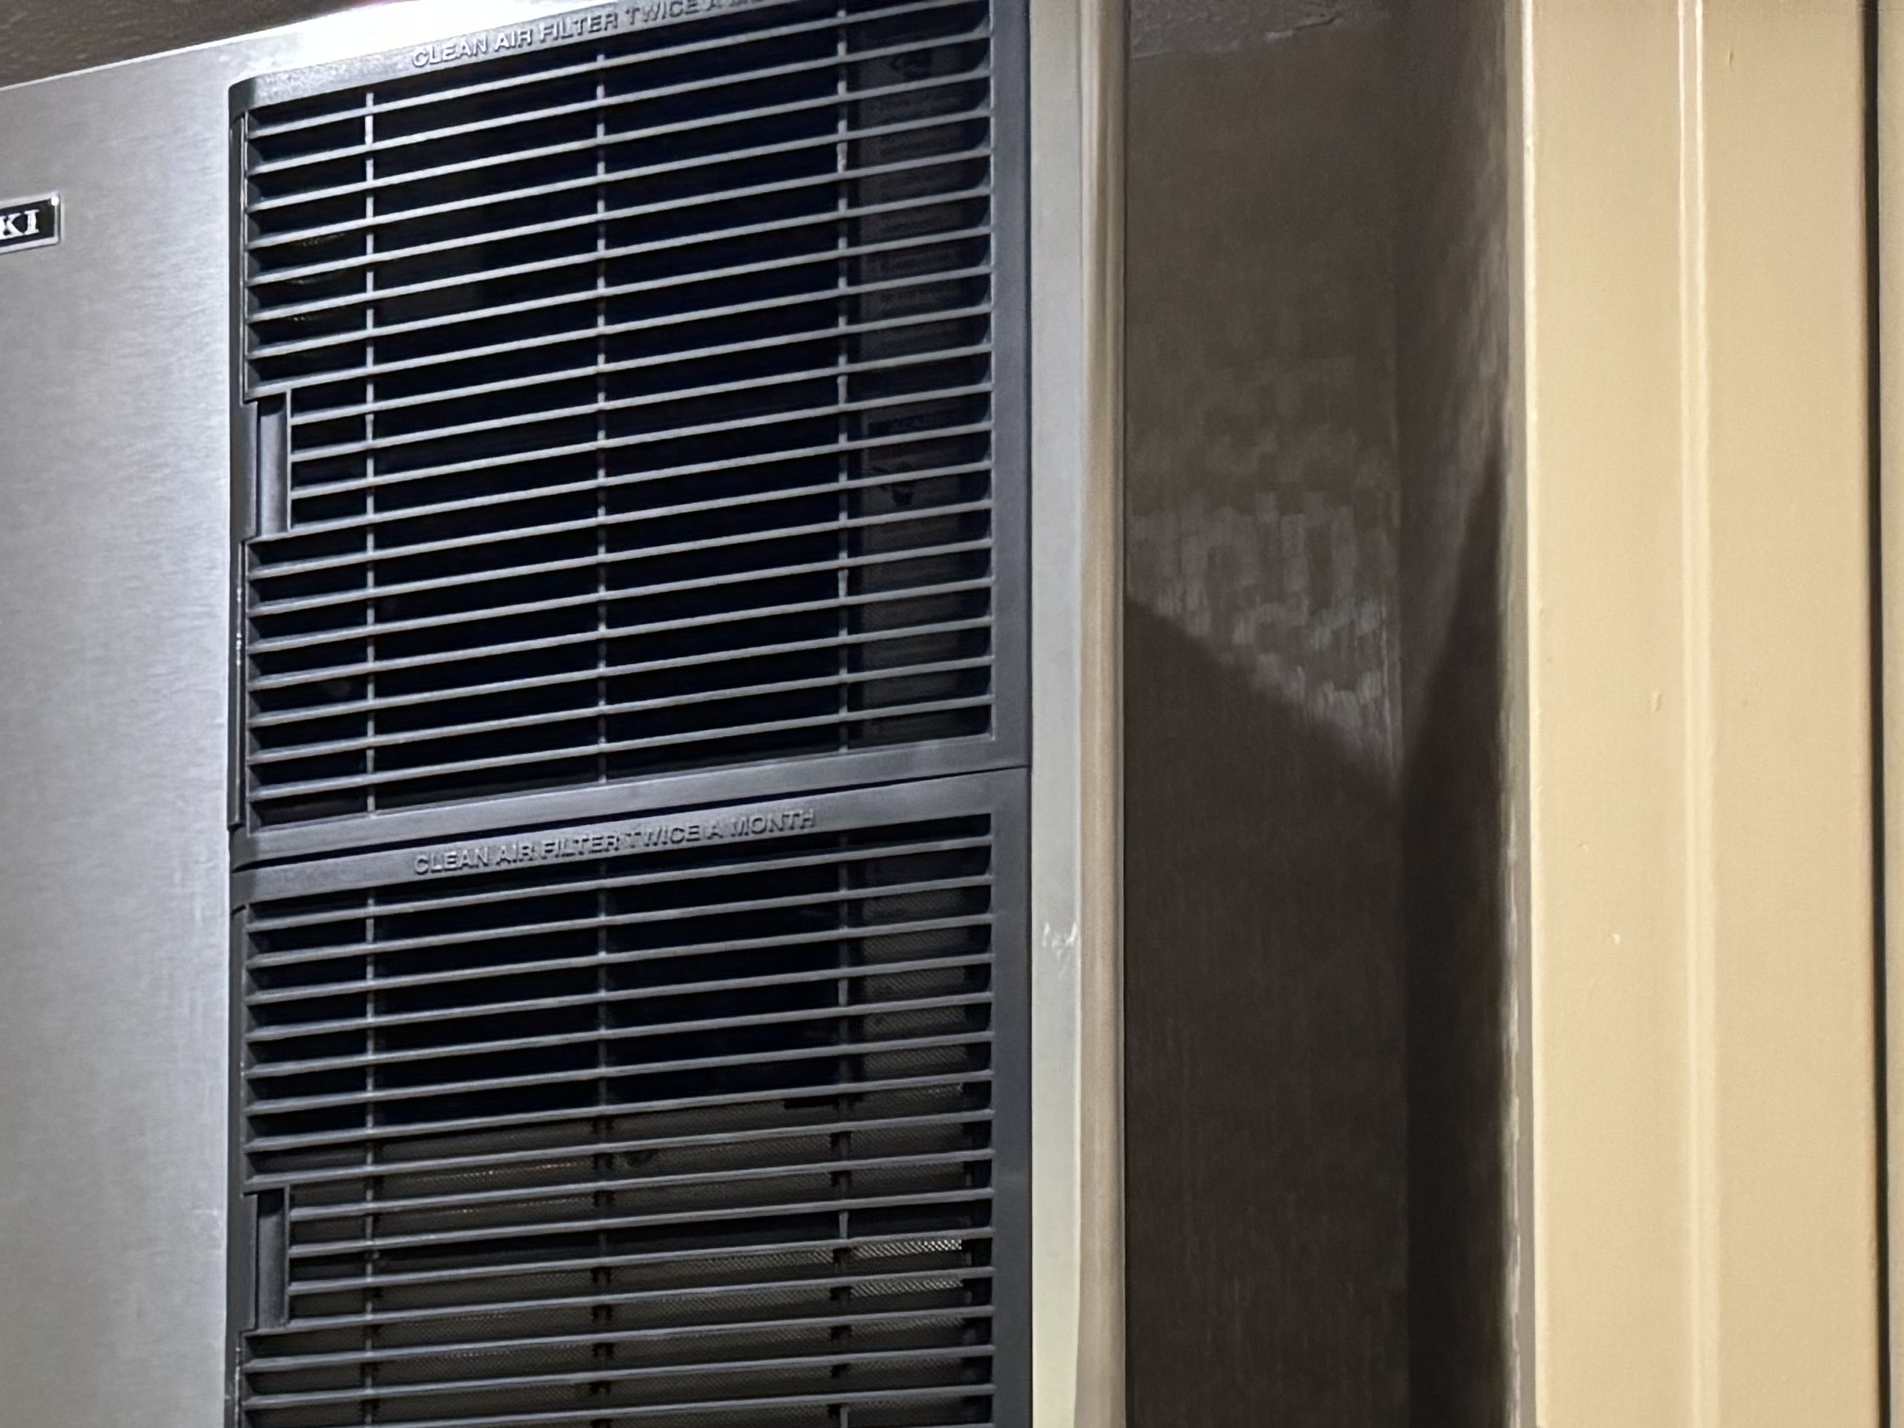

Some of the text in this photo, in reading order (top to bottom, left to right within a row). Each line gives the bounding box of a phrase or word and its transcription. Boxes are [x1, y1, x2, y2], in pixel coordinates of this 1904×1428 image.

[411, 34, 490, 68] CLEAN
[495, 28, 533, 51] AIR
[540, 12, 618, 43] FILTER
[625, 0, 700, 26] TWICE
[413, 807, 818, 876] CLEAN AIR FILTER TWICE A MONTH
